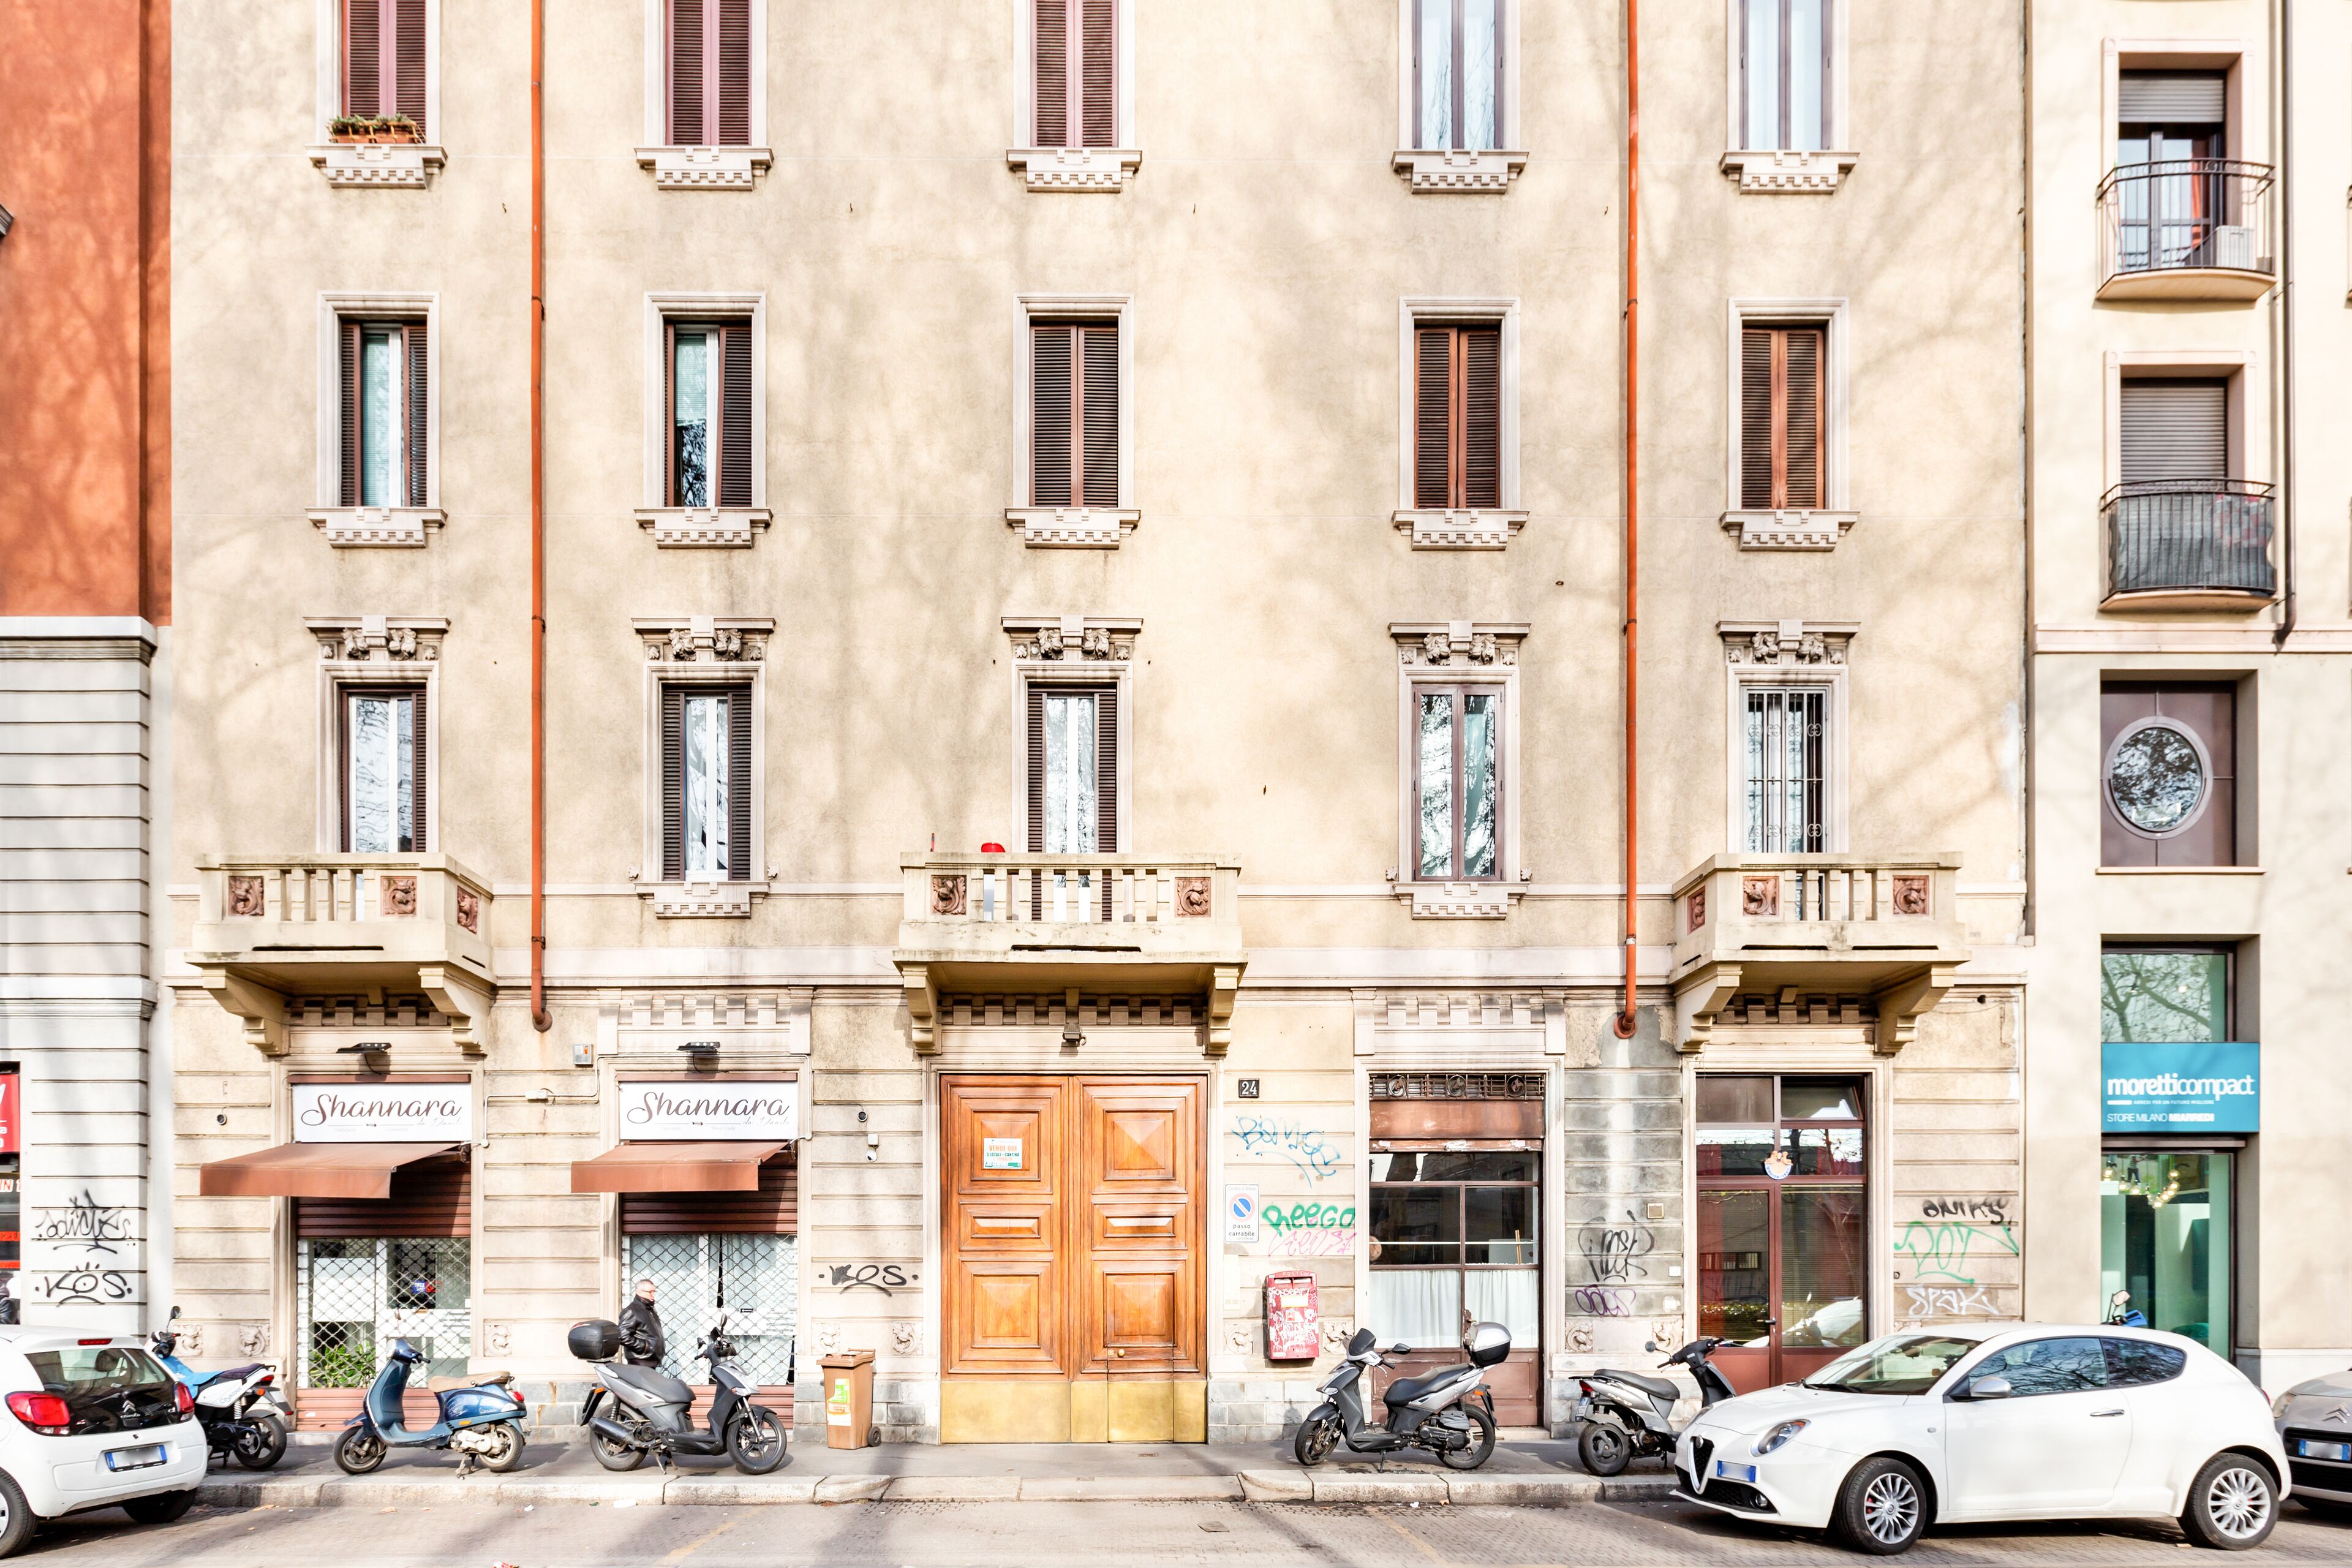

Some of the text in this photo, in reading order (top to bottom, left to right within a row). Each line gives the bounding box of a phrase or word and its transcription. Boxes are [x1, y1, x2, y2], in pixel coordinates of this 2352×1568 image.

[1242, 1081, 1257, 1095] 24
[2107, 1073, 2256, 1101] moretticompact
[301, 1094, 462, 1126] Shannara
[627, 1091, 790, 1124] Shannara
[2107, 1113, 2135, 1121] STORE
[2136, 1113, 2168, 1121] MILANO
